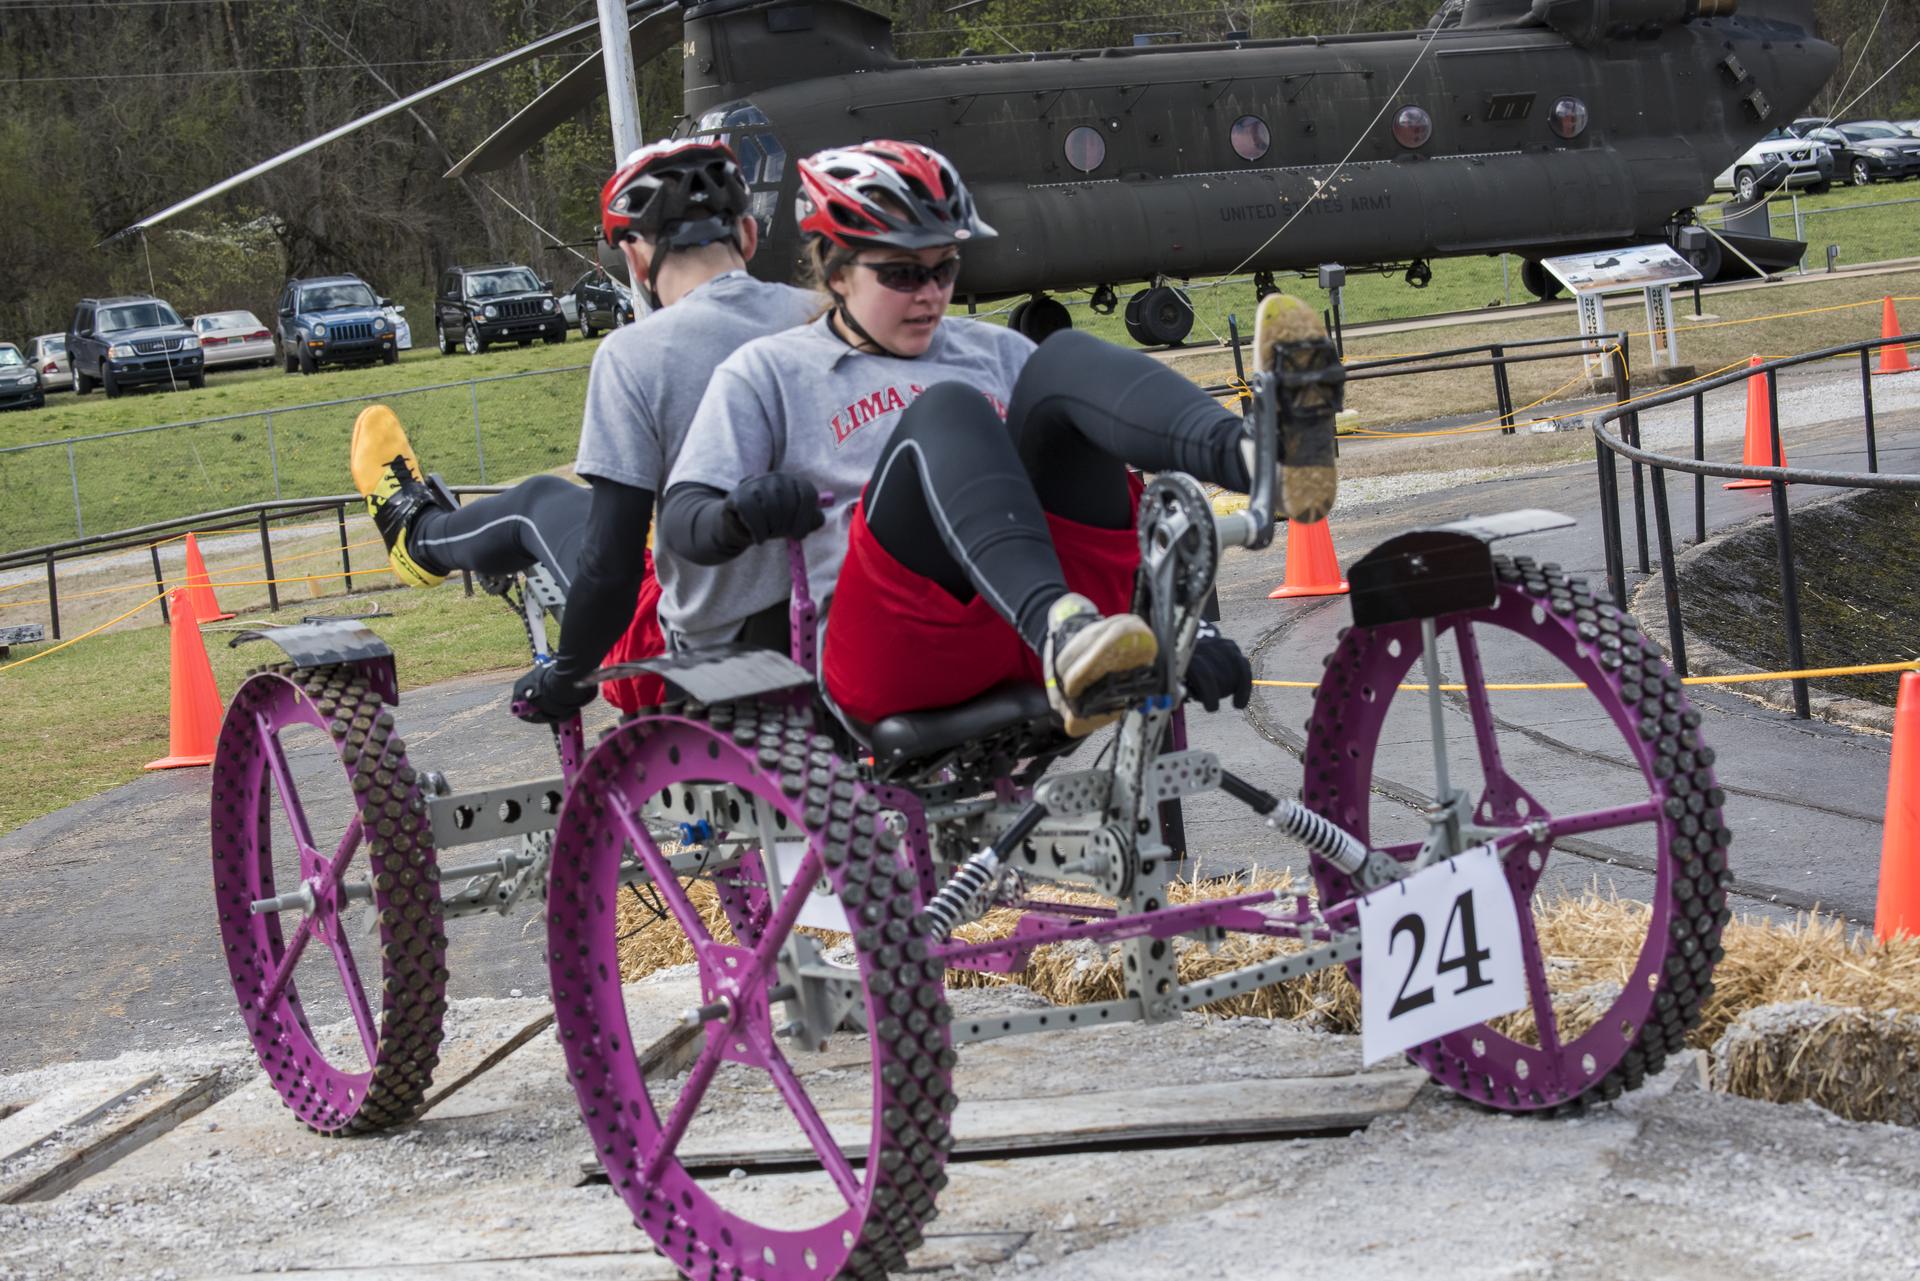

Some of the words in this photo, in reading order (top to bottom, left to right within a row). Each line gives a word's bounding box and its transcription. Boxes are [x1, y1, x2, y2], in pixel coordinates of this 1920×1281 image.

[1220, 203, 1277, 222] UNITED
[1283, 201, 1344, 216] STATES
[1351, 195, 1393, 211] ARMY
[1652, 289, 1662, 335] CH-47D
[1657, 289, 1668, 349] CHINOOK
[830, 385, 906, 447] LIMA
[1388, 888, 1494, 1020] 24
